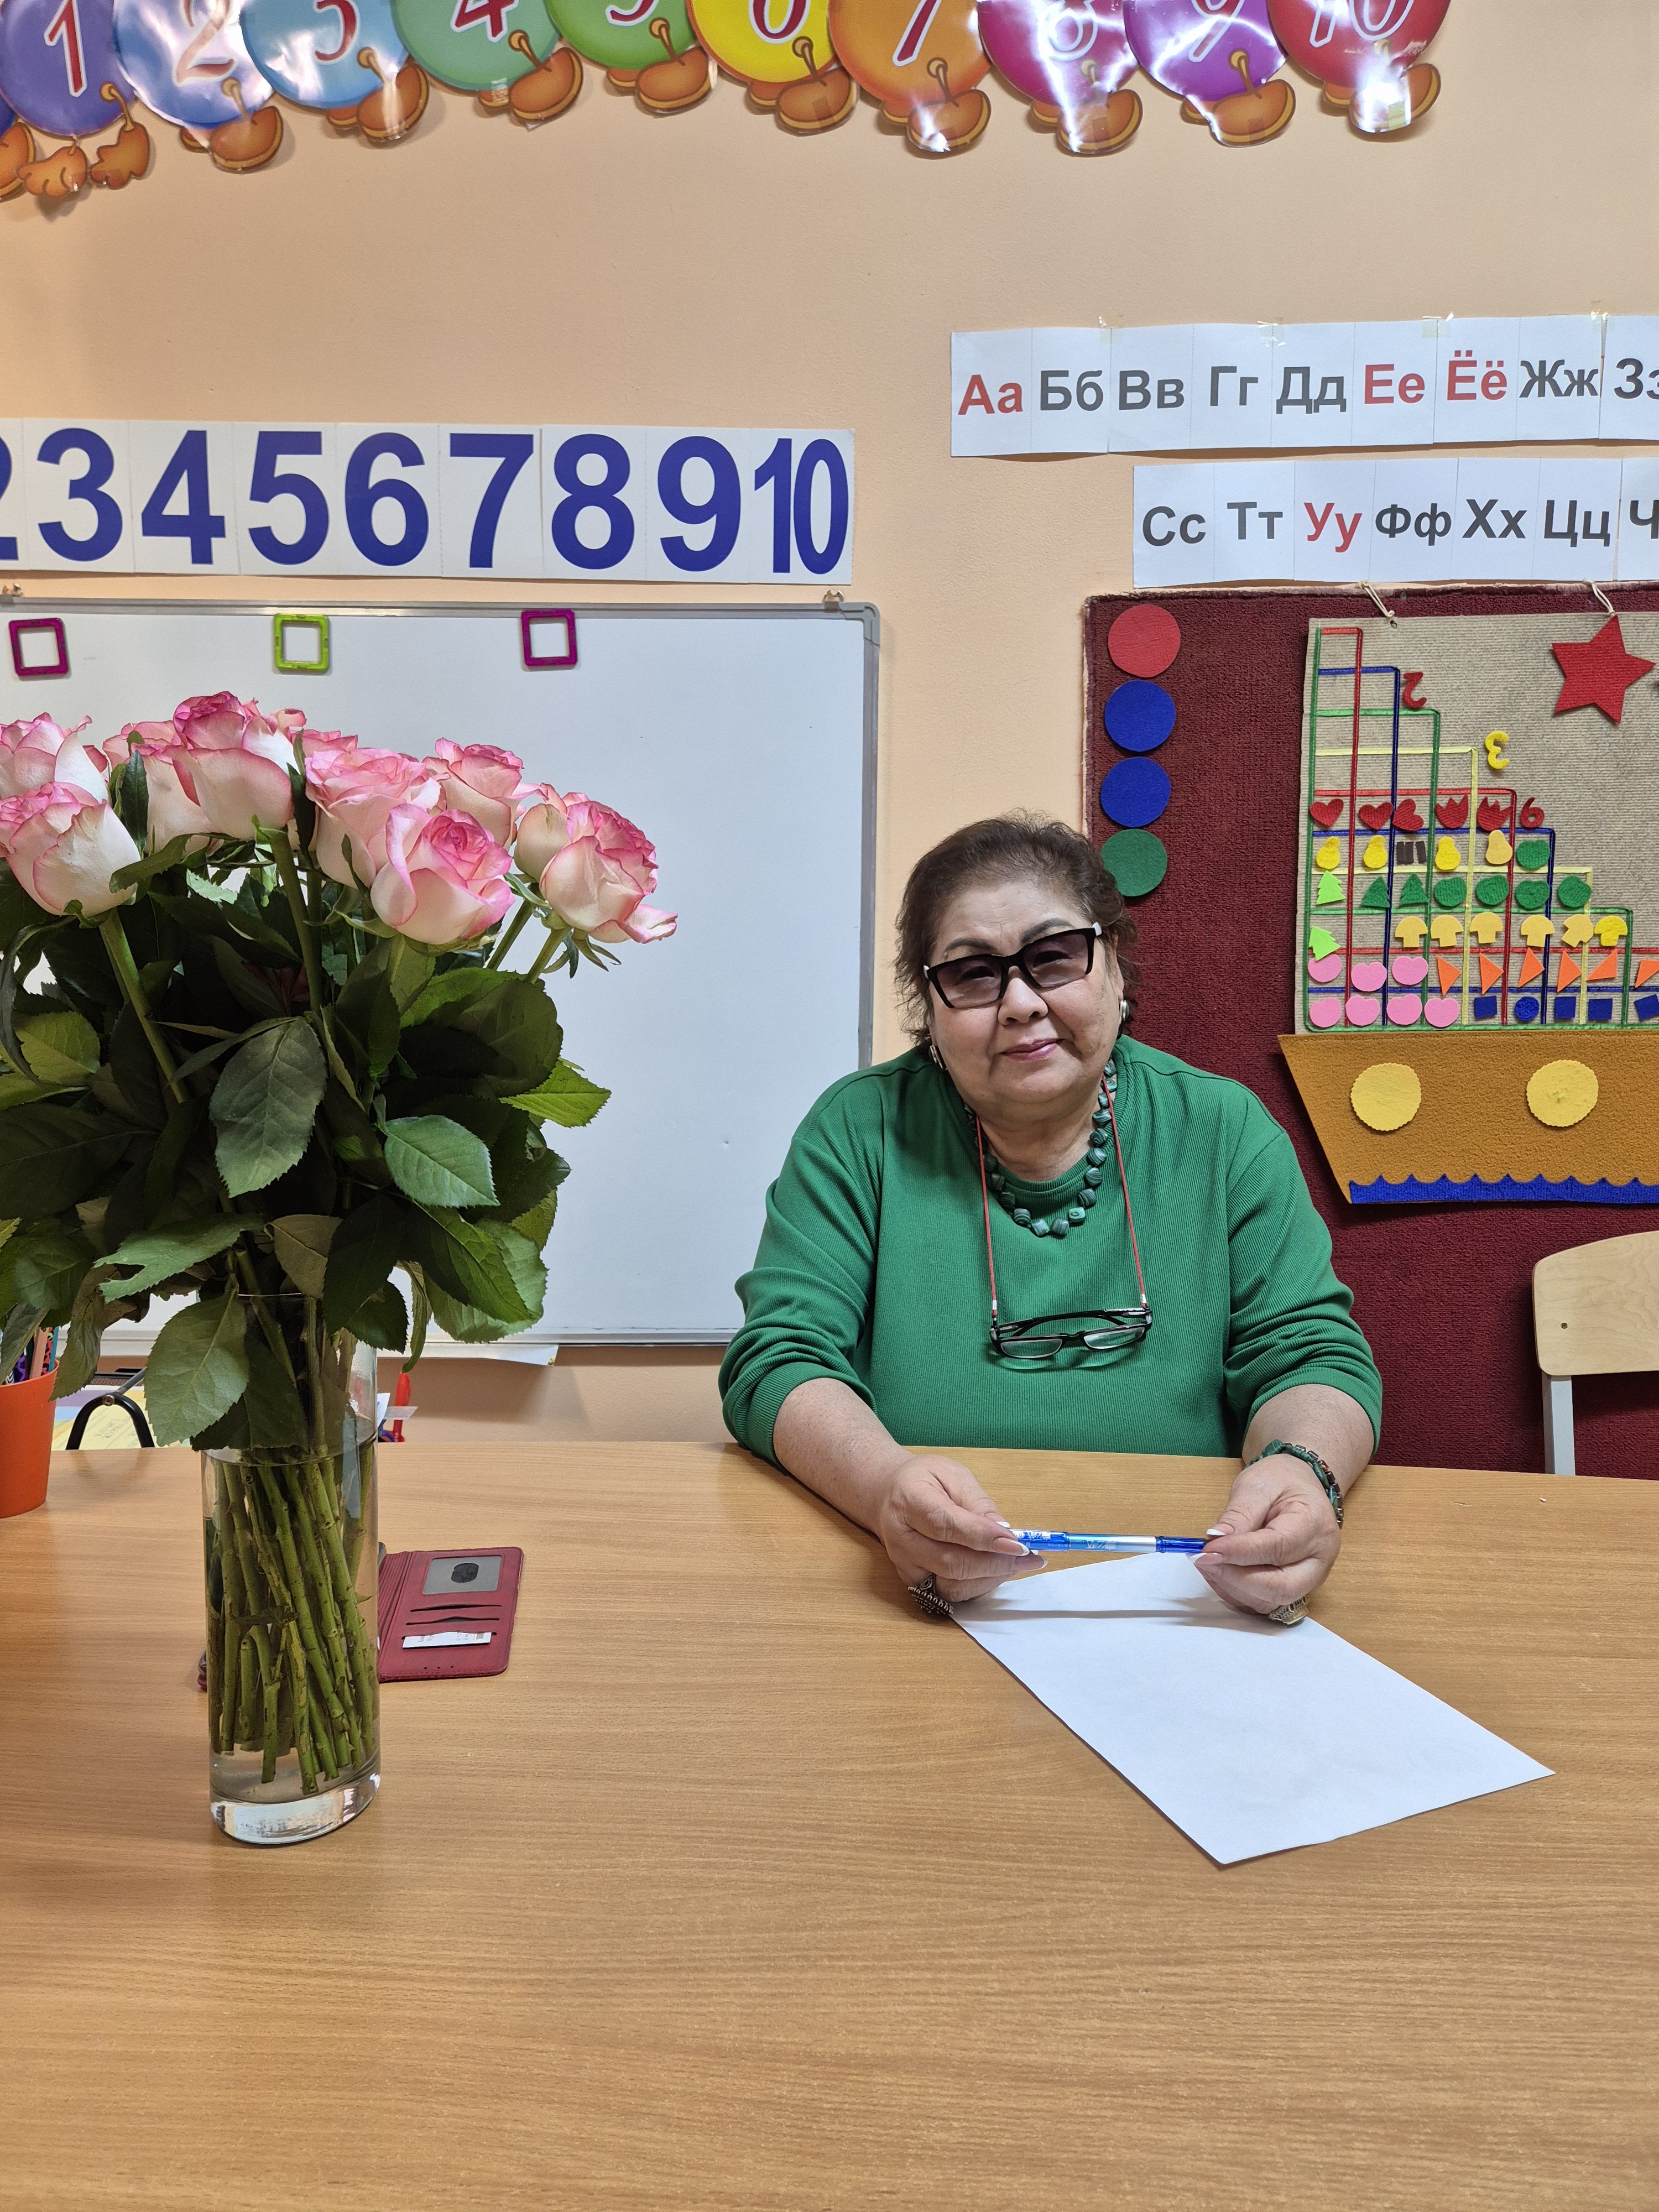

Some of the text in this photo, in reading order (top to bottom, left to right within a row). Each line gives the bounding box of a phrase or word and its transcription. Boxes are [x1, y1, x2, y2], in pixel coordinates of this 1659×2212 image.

[44, 0, 87, 97] 1
[958, 374, 1023, 415] Аа
[1040, 370, 1104, 411] Бб
[1118, 369, 1185, 410] Вв
[1209, 366, 1259, 406] Гг
[1276, 366, 1347, 414] Дд
[1364, 363, 1425, 405] Ее
[1447, 349, 1507, 401] Ёё
[1519, 359, 1599, 398] Жж
[37, 428, 123, 561] 3
[142, 430, 226, 565] 4
[249, 431, 330, 565] 5
[345, 432, 429, 566] 6
[450, 433, 534, 568] 7
[551, 434, 635, 570] 8
[658, 435, 742, 572] 9
[754, 438, 849, 575] 10
[1142, 506, 1207, 546] Сс
[1227, 502, 1284, 540] Тт
[1304, 502, 1362, 552] Уу
[1375, 503, 1452, 546] Фф
[1462, 499, 1527, 539] Хх
[1543, 499, 1610, 547] Цц
